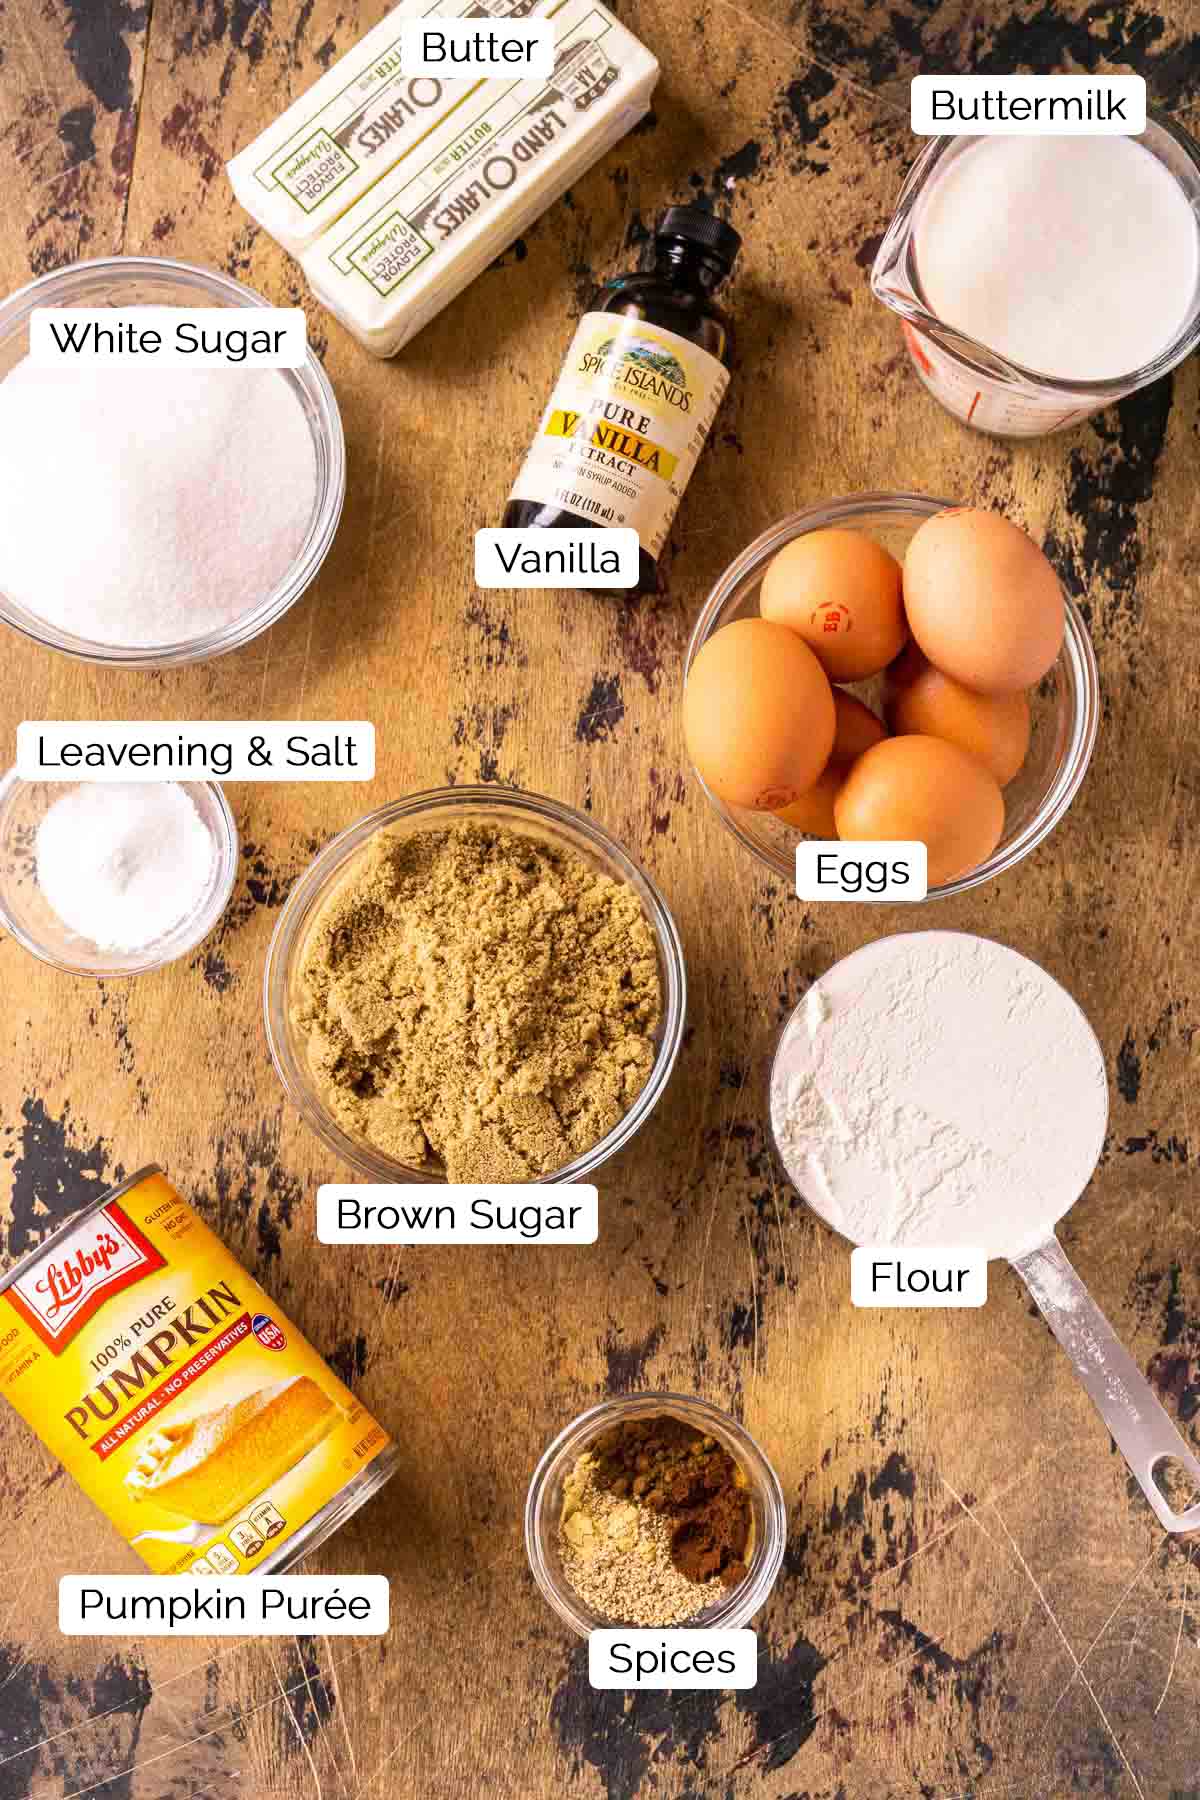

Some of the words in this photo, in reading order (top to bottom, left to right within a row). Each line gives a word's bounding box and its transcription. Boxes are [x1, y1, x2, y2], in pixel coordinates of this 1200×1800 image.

[357, 97, 417, 154] LAKES
[449, 121, 493, 162] BUTTER
[512, 110, 567, 162] LAND
[294, 150, 341, 195] PROTECT
[305, 160, 346, 200] FLAVOR
[482, 156, 517, 190] O
[432, 179, 492, 237] LAKES
[371, 232, 418, 279] PROTECT
[383, 244, 422, 283] FLAVOR
[623, 366, 694, 413] ISLANDS
[590, 398, 651, 436] PURE
[562, 410, 661, 473] VANILLA
[35, 1233, 121, 1319] Libby's
[89, 1335, 131, 1373] 100%
[129, 1295, 177, 1338] PURE
[258, 1325, 280, 1345] USA
[63, 1279, 242, 1441] PUMPKIN
[100, 1435, 116, 1453] ALL
[115, 1397, 161, 1440] NATURAL
[165, 1377, 182, 1396] NO
[181, 1321, 249, 1384] PRESERVATIVES
